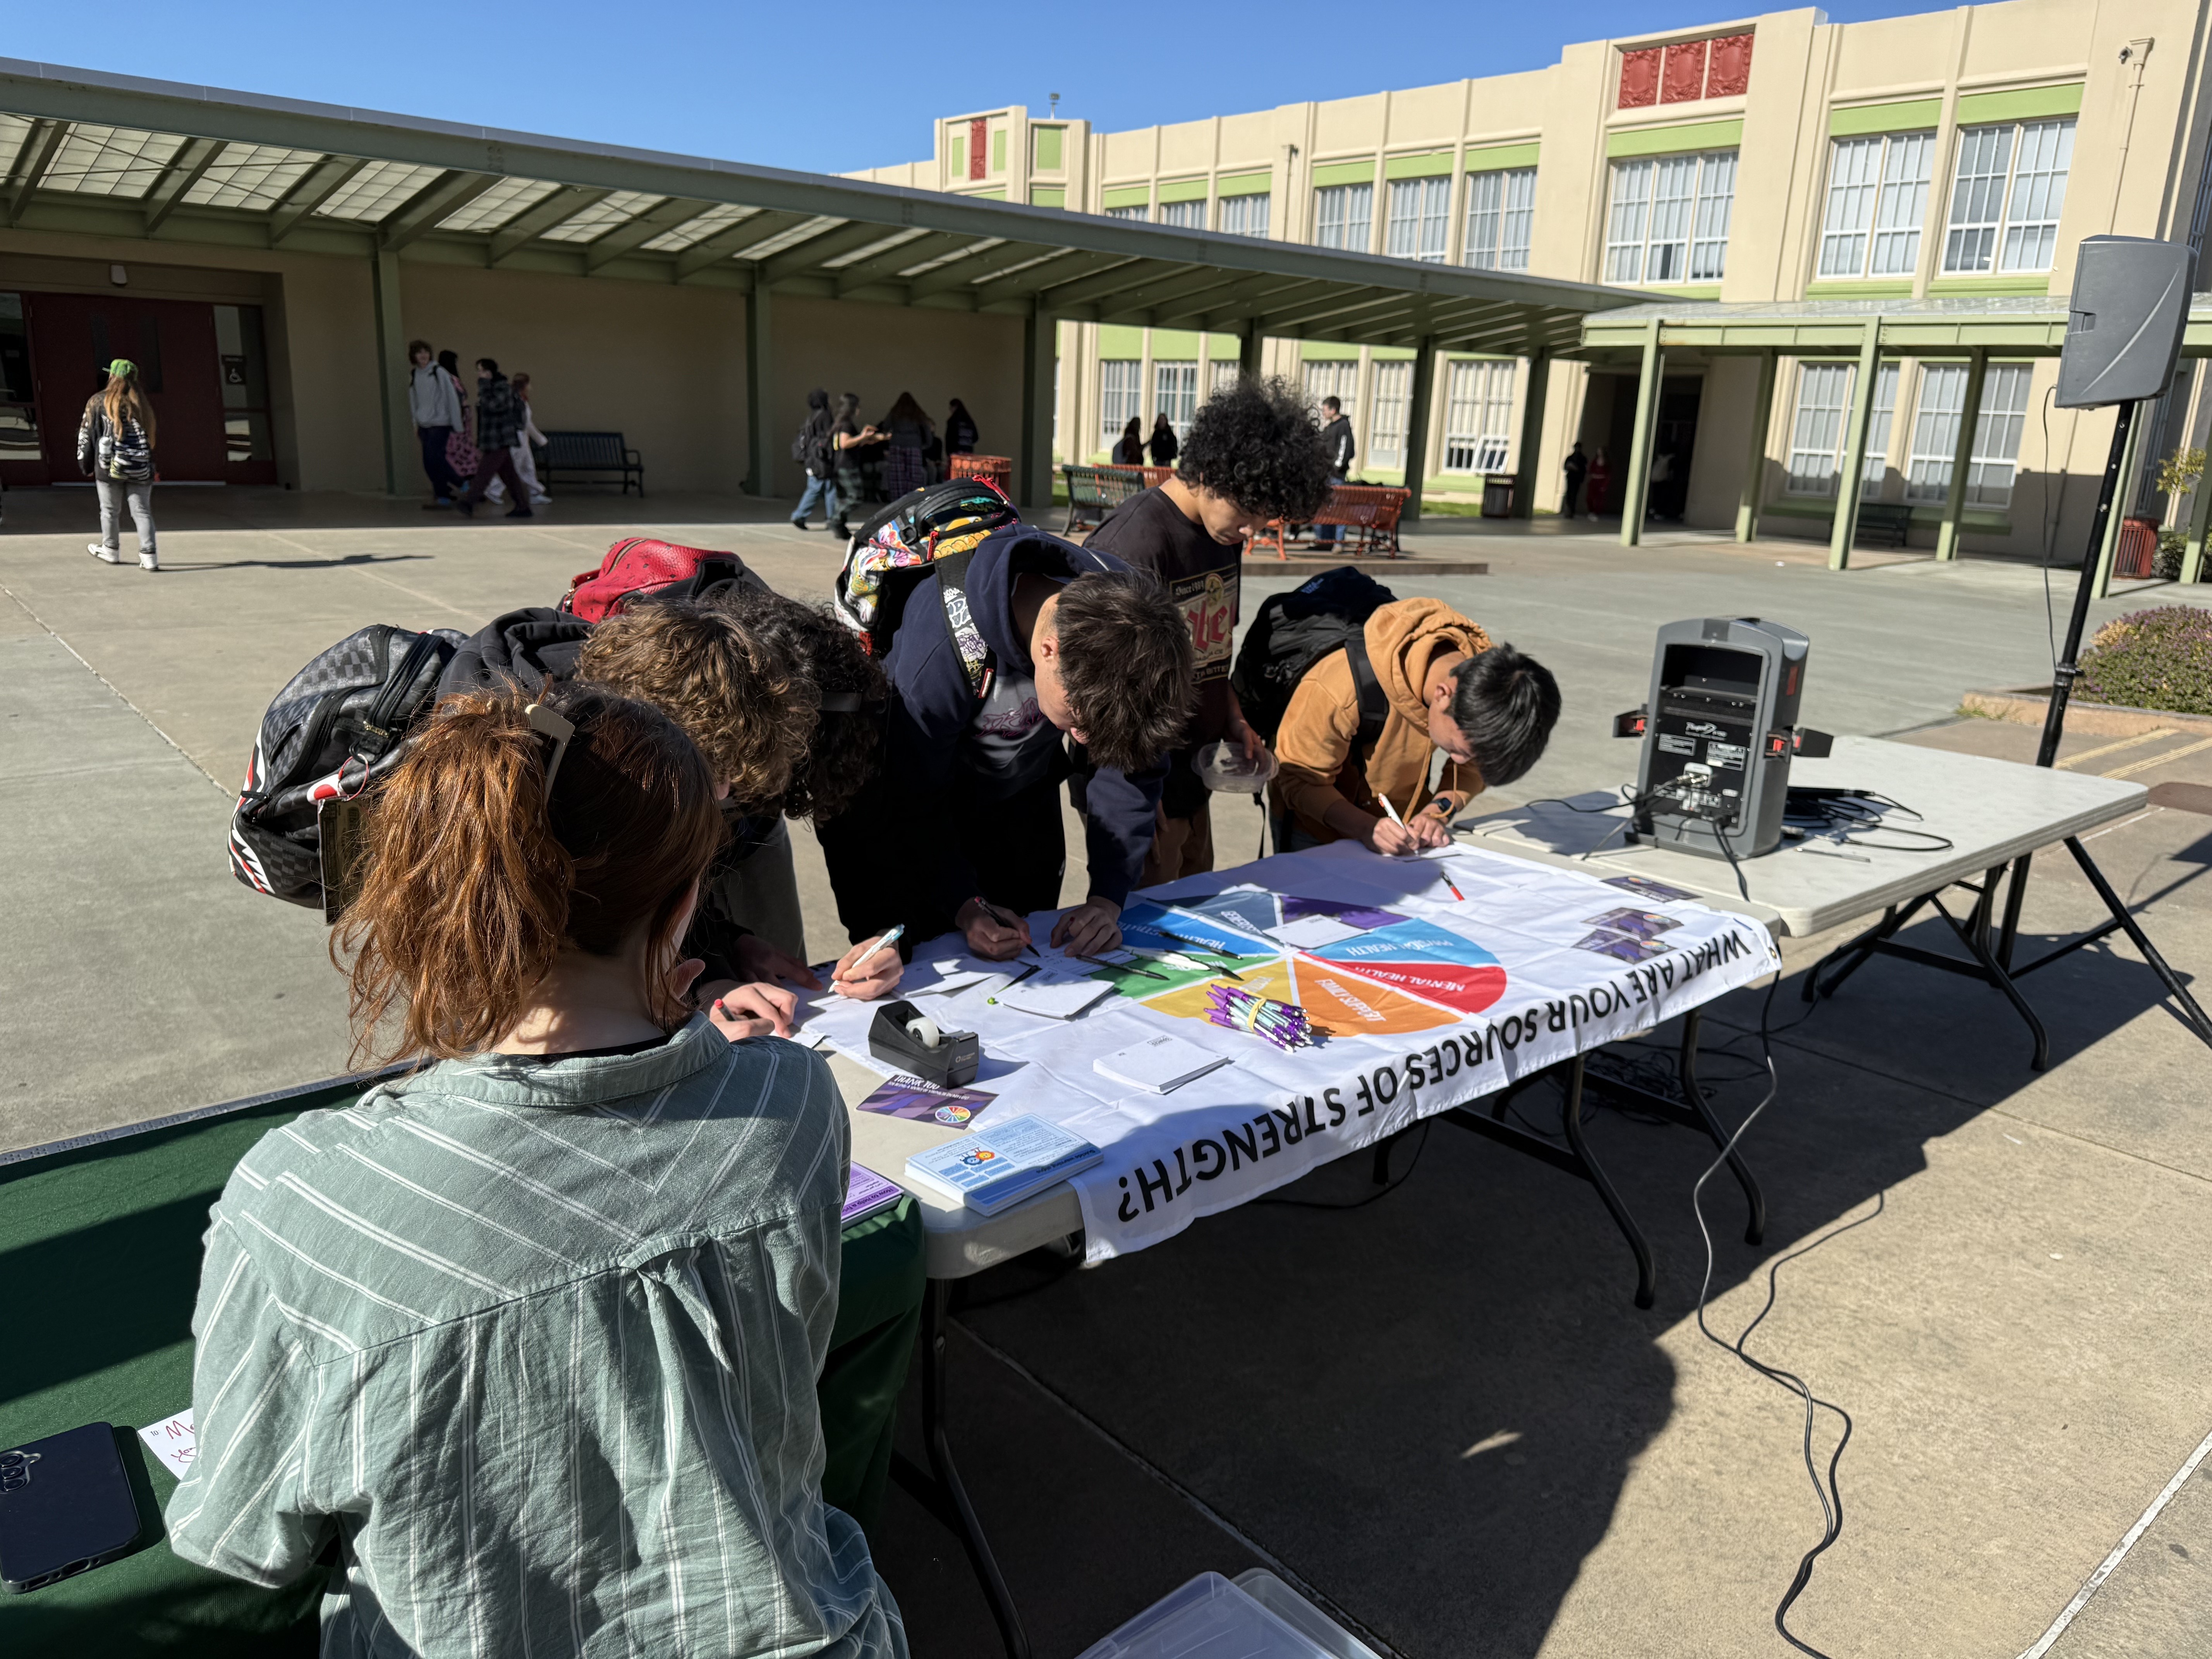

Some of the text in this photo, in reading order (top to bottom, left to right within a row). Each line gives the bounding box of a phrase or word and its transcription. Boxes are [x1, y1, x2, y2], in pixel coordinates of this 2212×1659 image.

[1345, 943, 1398, 957] HEALTH
[1680, 930, 1752, 982] WHAT
[1409, 975, 1466, 992] MENTAL
[1545, 980, 1630, 1032] YOUR
[1625, 958, 1674, 1003] ARE
[1406, 1009, 1538, 1090] SOURCES
[894, 1075, 940, 1090] THANK YOU
[1357, 1066, 1398, 1117] OF
[1118, 1087, 1346, 1222] STRENGTH?
